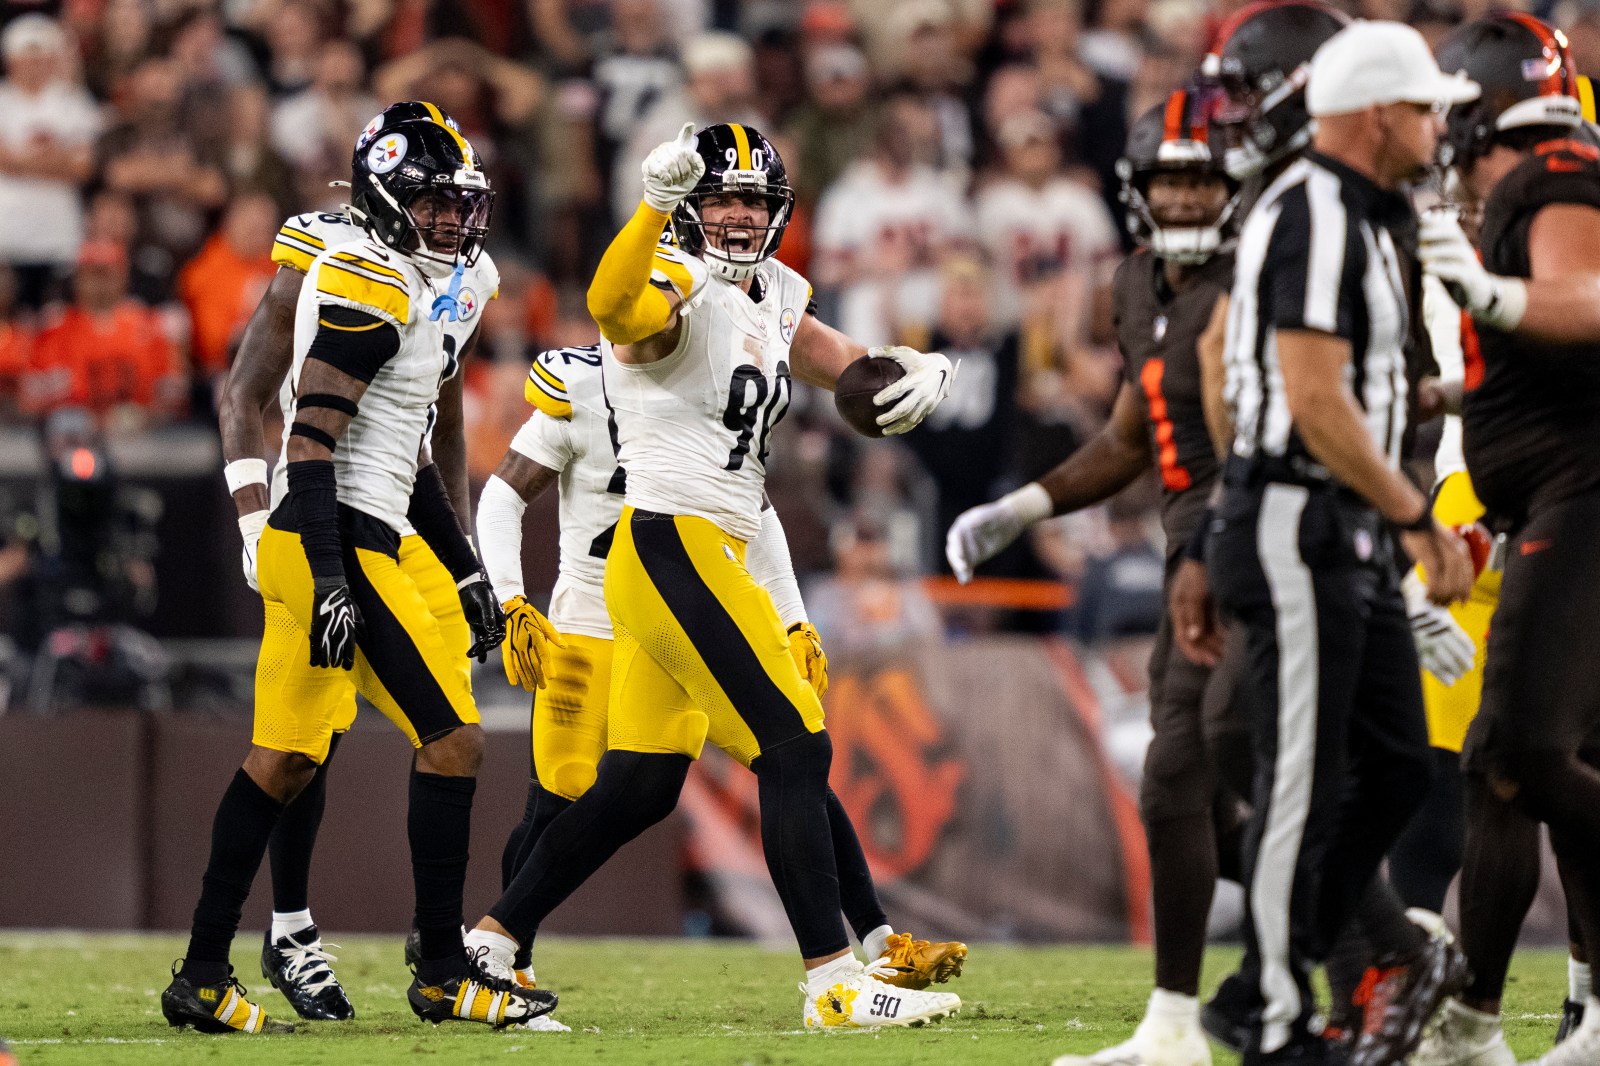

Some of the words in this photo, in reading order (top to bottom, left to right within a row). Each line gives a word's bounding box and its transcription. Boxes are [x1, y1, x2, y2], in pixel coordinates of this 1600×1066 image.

[724, 147, 764, 171] 90
[317, 213, 351, 226] 8
[556, 344, 602, 367] 22
[722, 360, 792, 471] 90
[1140, 357, 1191, 491] 1
[869, 993, 902, 1018] 90
